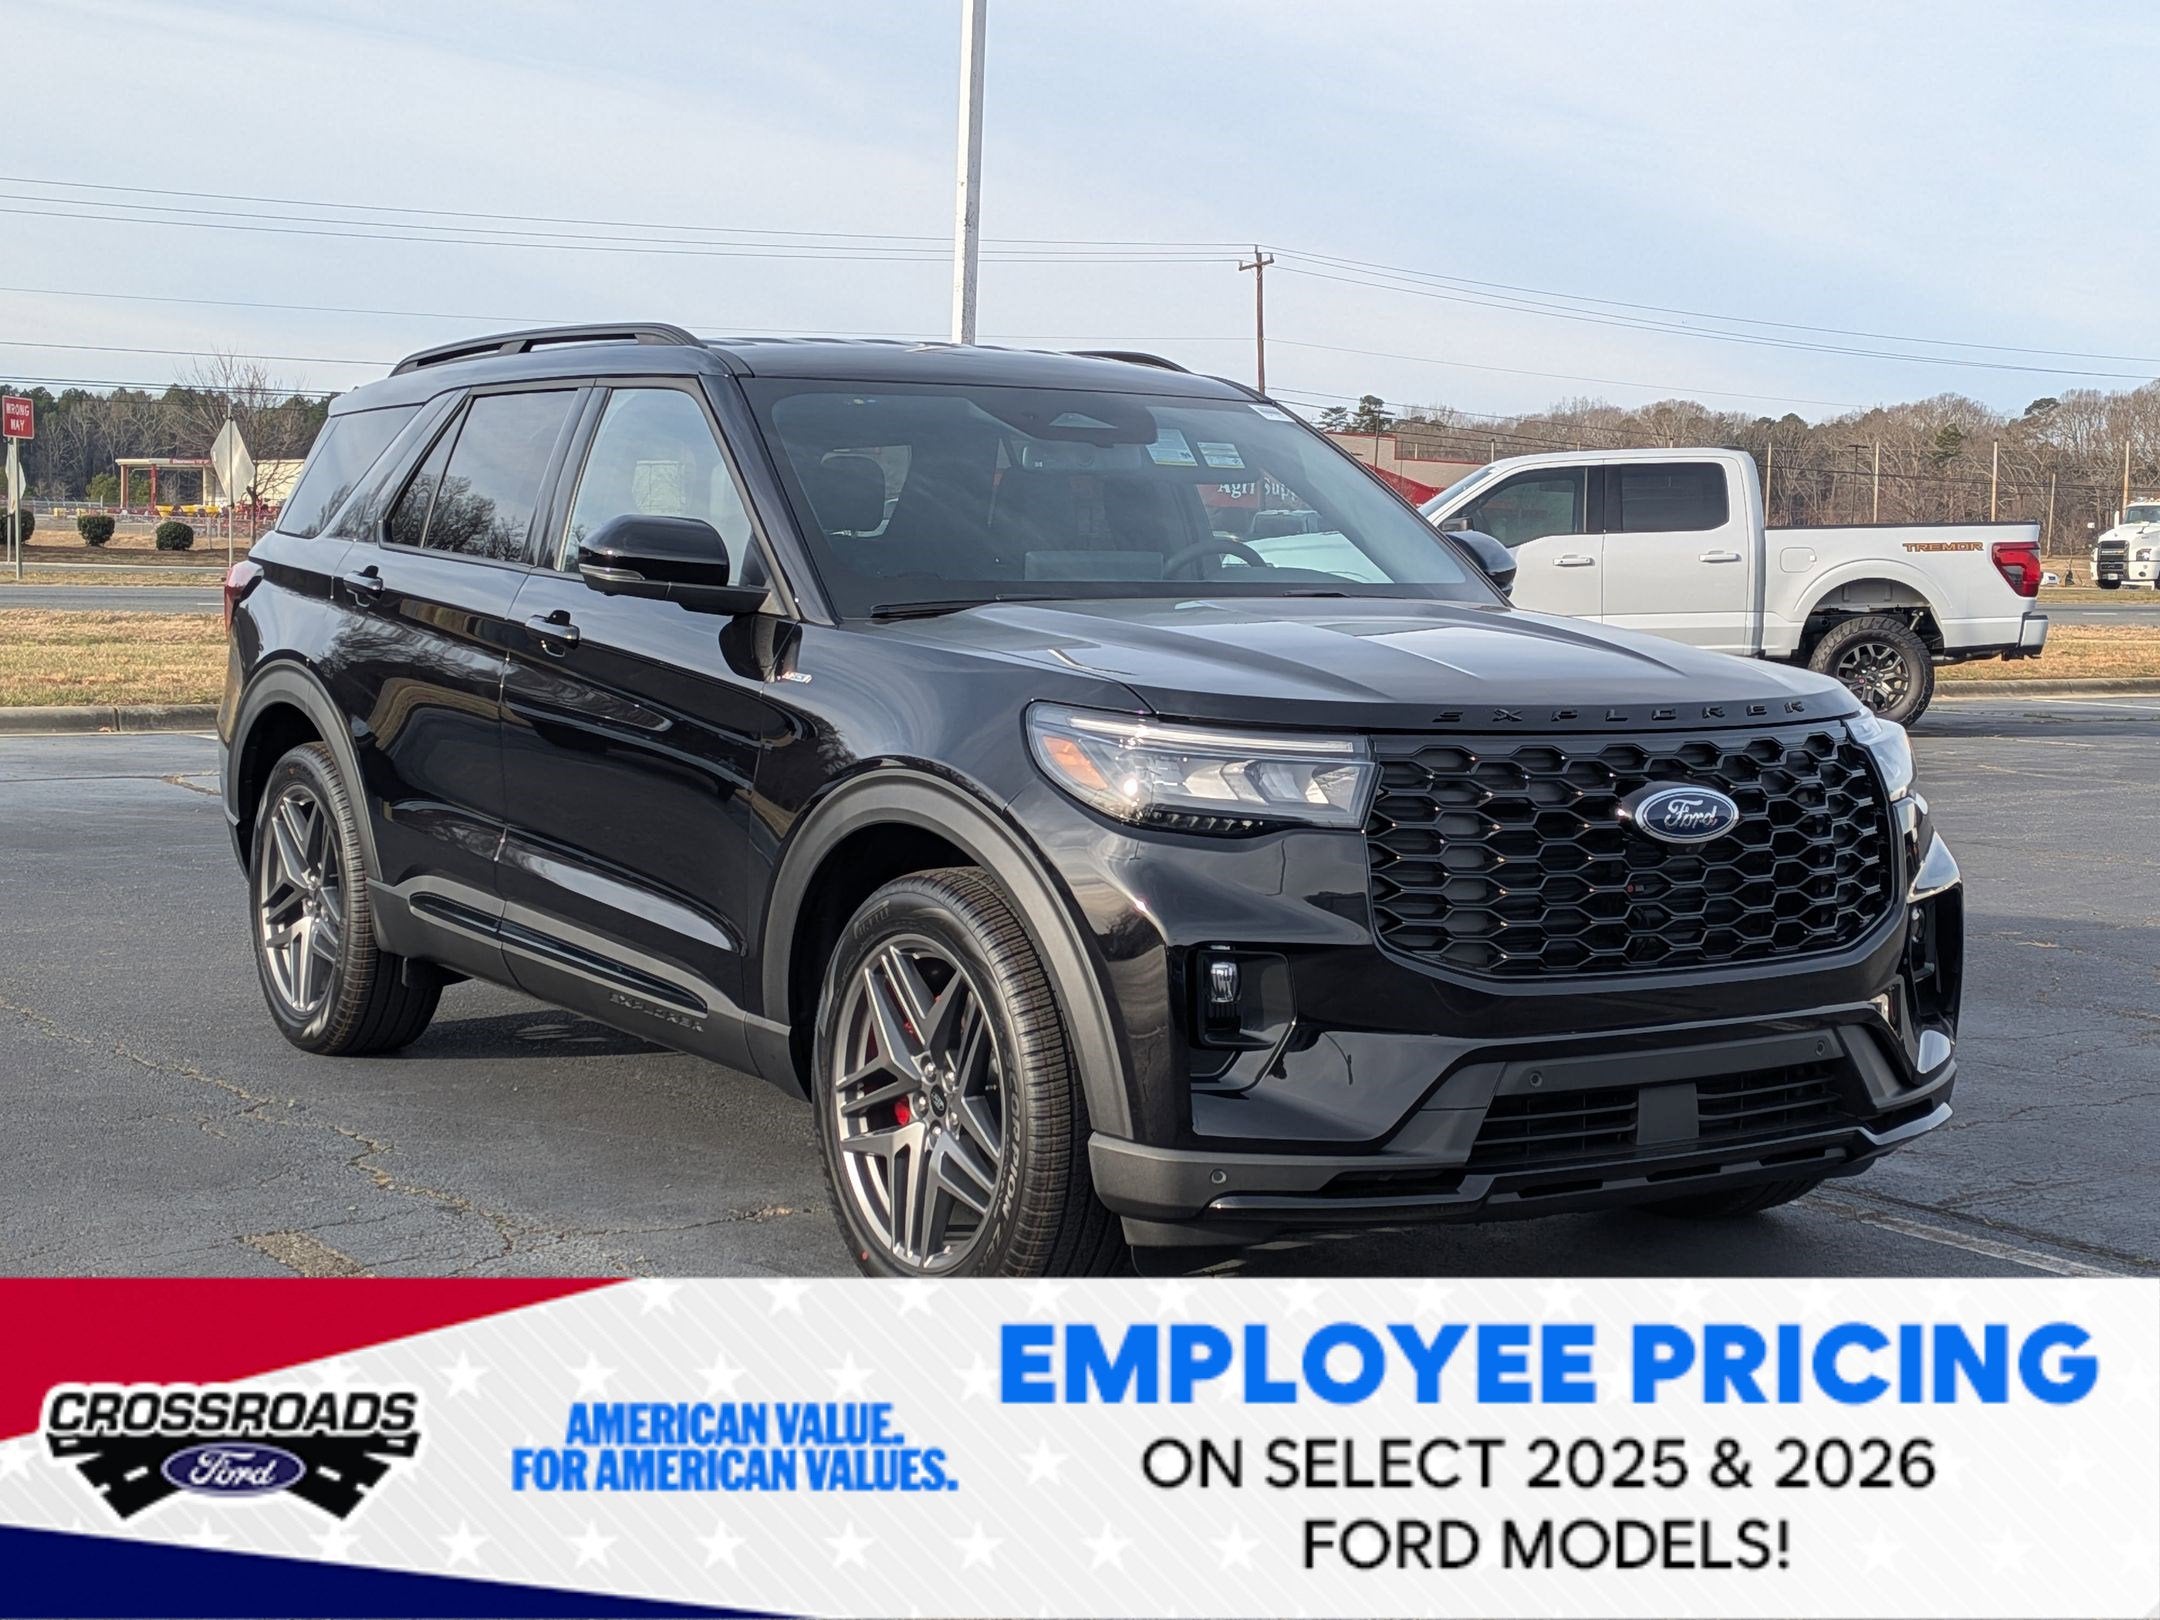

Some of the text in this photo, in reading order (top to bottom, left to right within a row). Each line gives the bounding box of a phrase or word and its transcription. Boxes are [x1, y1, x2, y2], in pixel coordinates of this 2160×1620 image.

[6, 402, 30, 417] WRONG
[10, 418, 25, 432] WAY
[1902, 541, 1984, 553] TREMOR
[1432, 701, 1804, 723] EXPLORER
[1664, 798, 1718, 830] Ford
[1002, 1050, 1021, 1221] SCORPION
